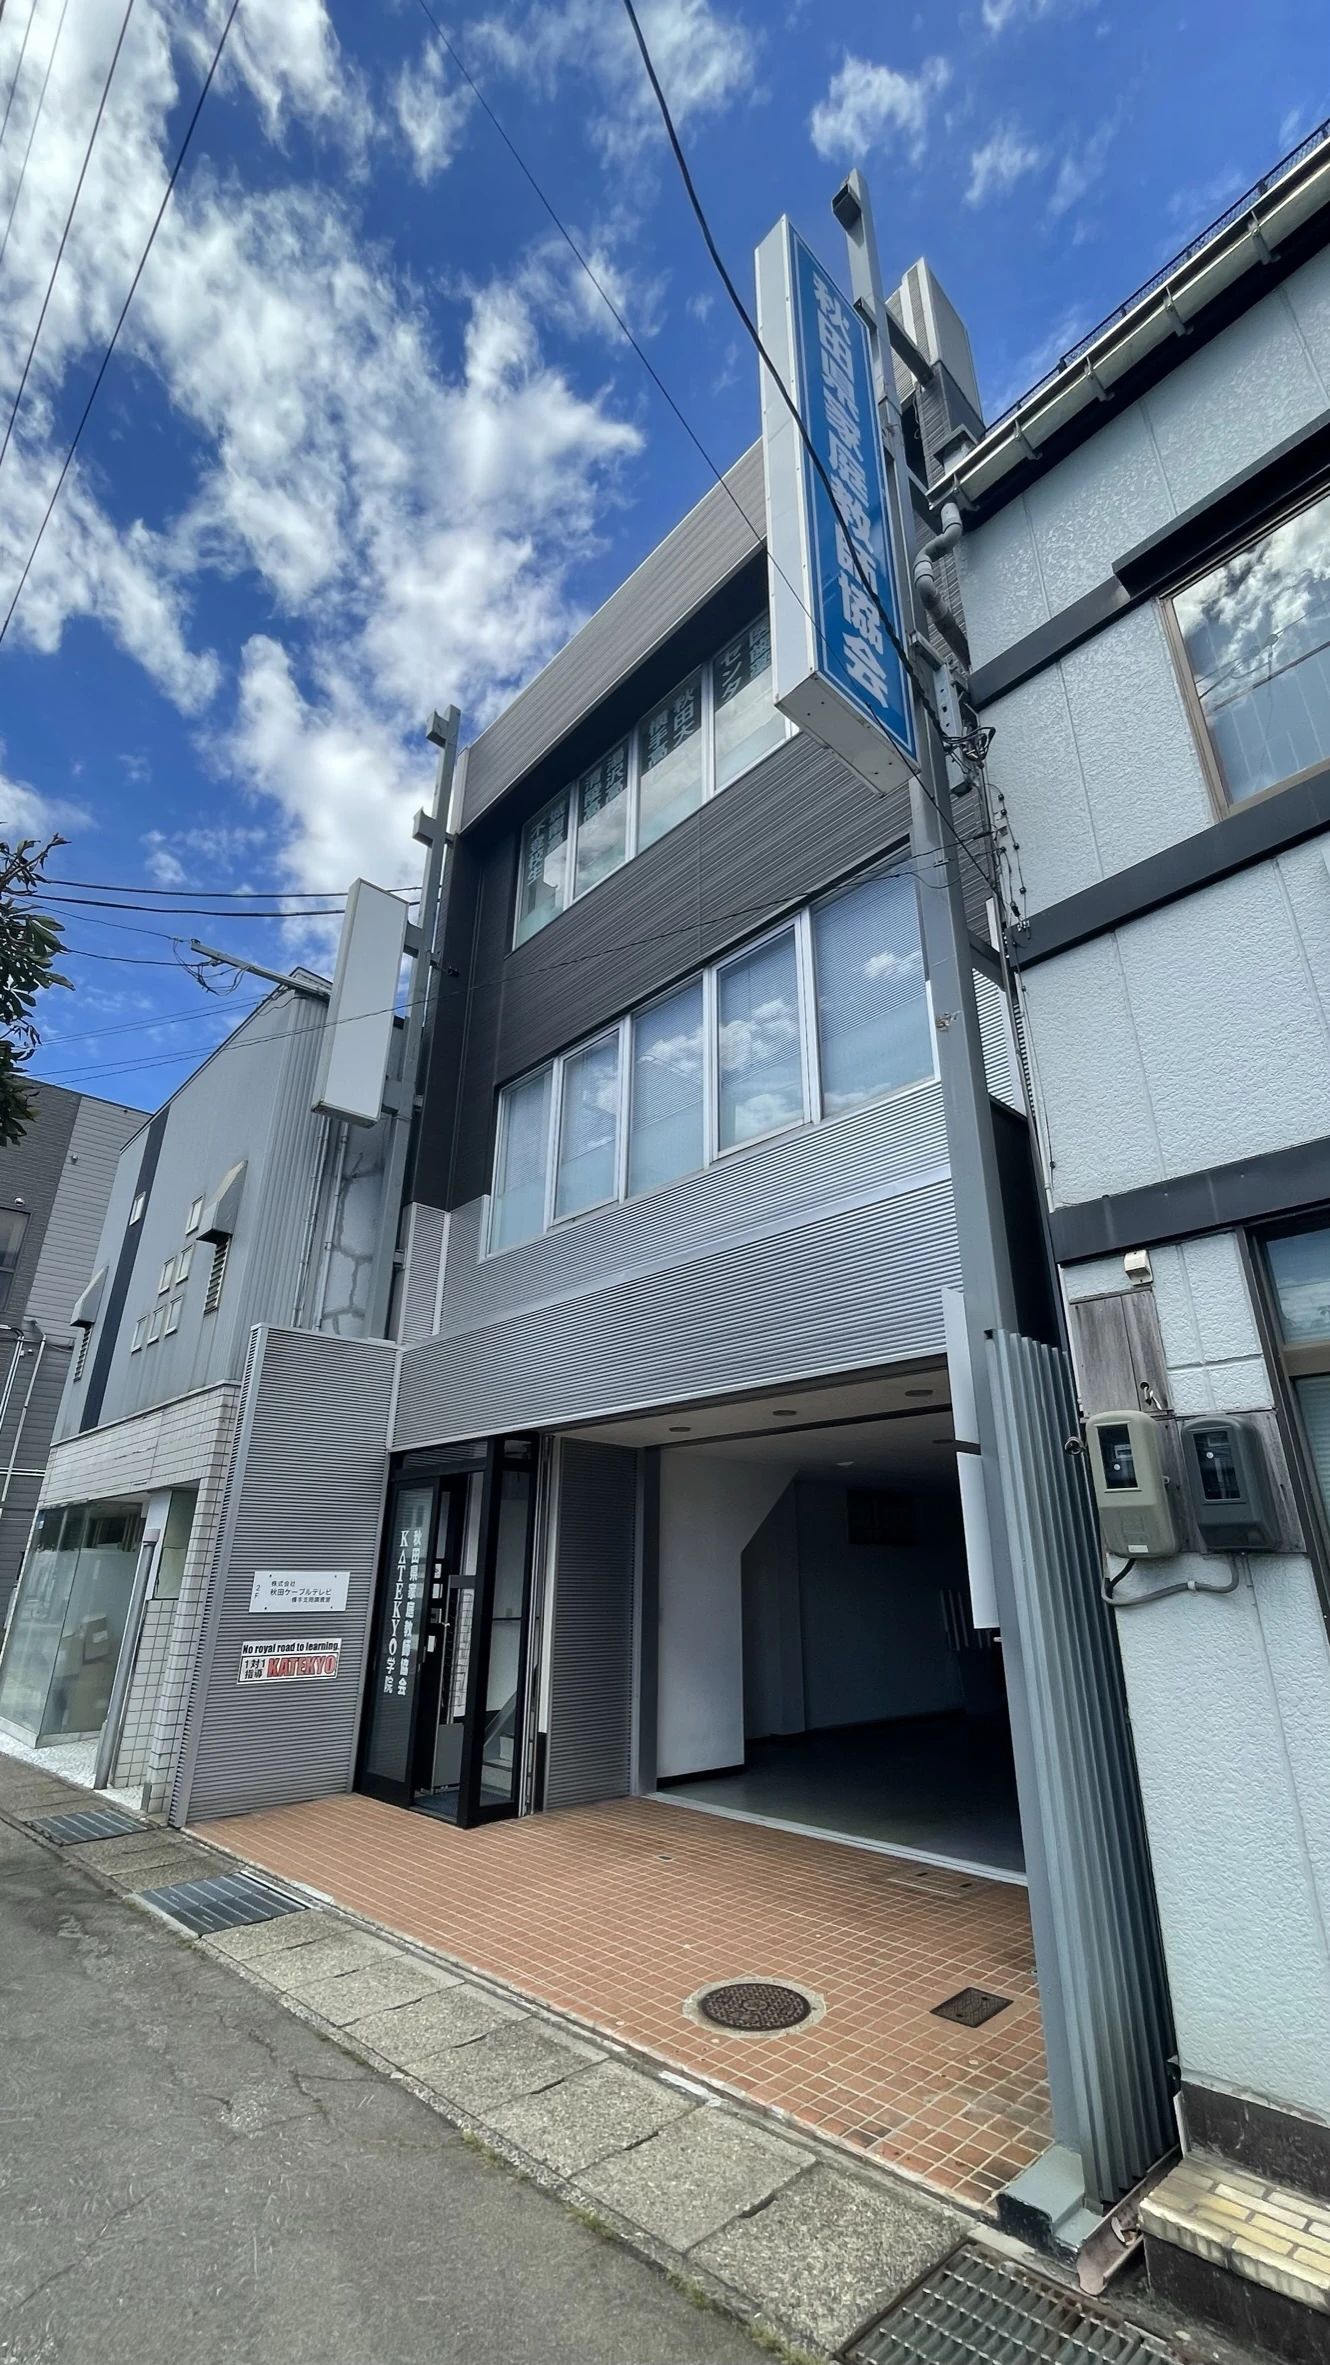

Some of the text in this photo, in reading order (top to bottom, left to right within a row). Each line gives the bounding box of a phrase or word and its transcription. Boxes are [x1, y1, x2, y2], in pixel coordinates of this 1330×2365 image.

[812, 271, 889, 709] 秋田県家庭教師協会
[270, 1588, 332, 1596] 秋田ケーブルテレビ
[397, 1529, 422, 1696] 秋田県家庭教師協会
[242, 1641, 339, 1654] No royal road to learning.
[267, 1655, 337, 1678] KATEKYO
